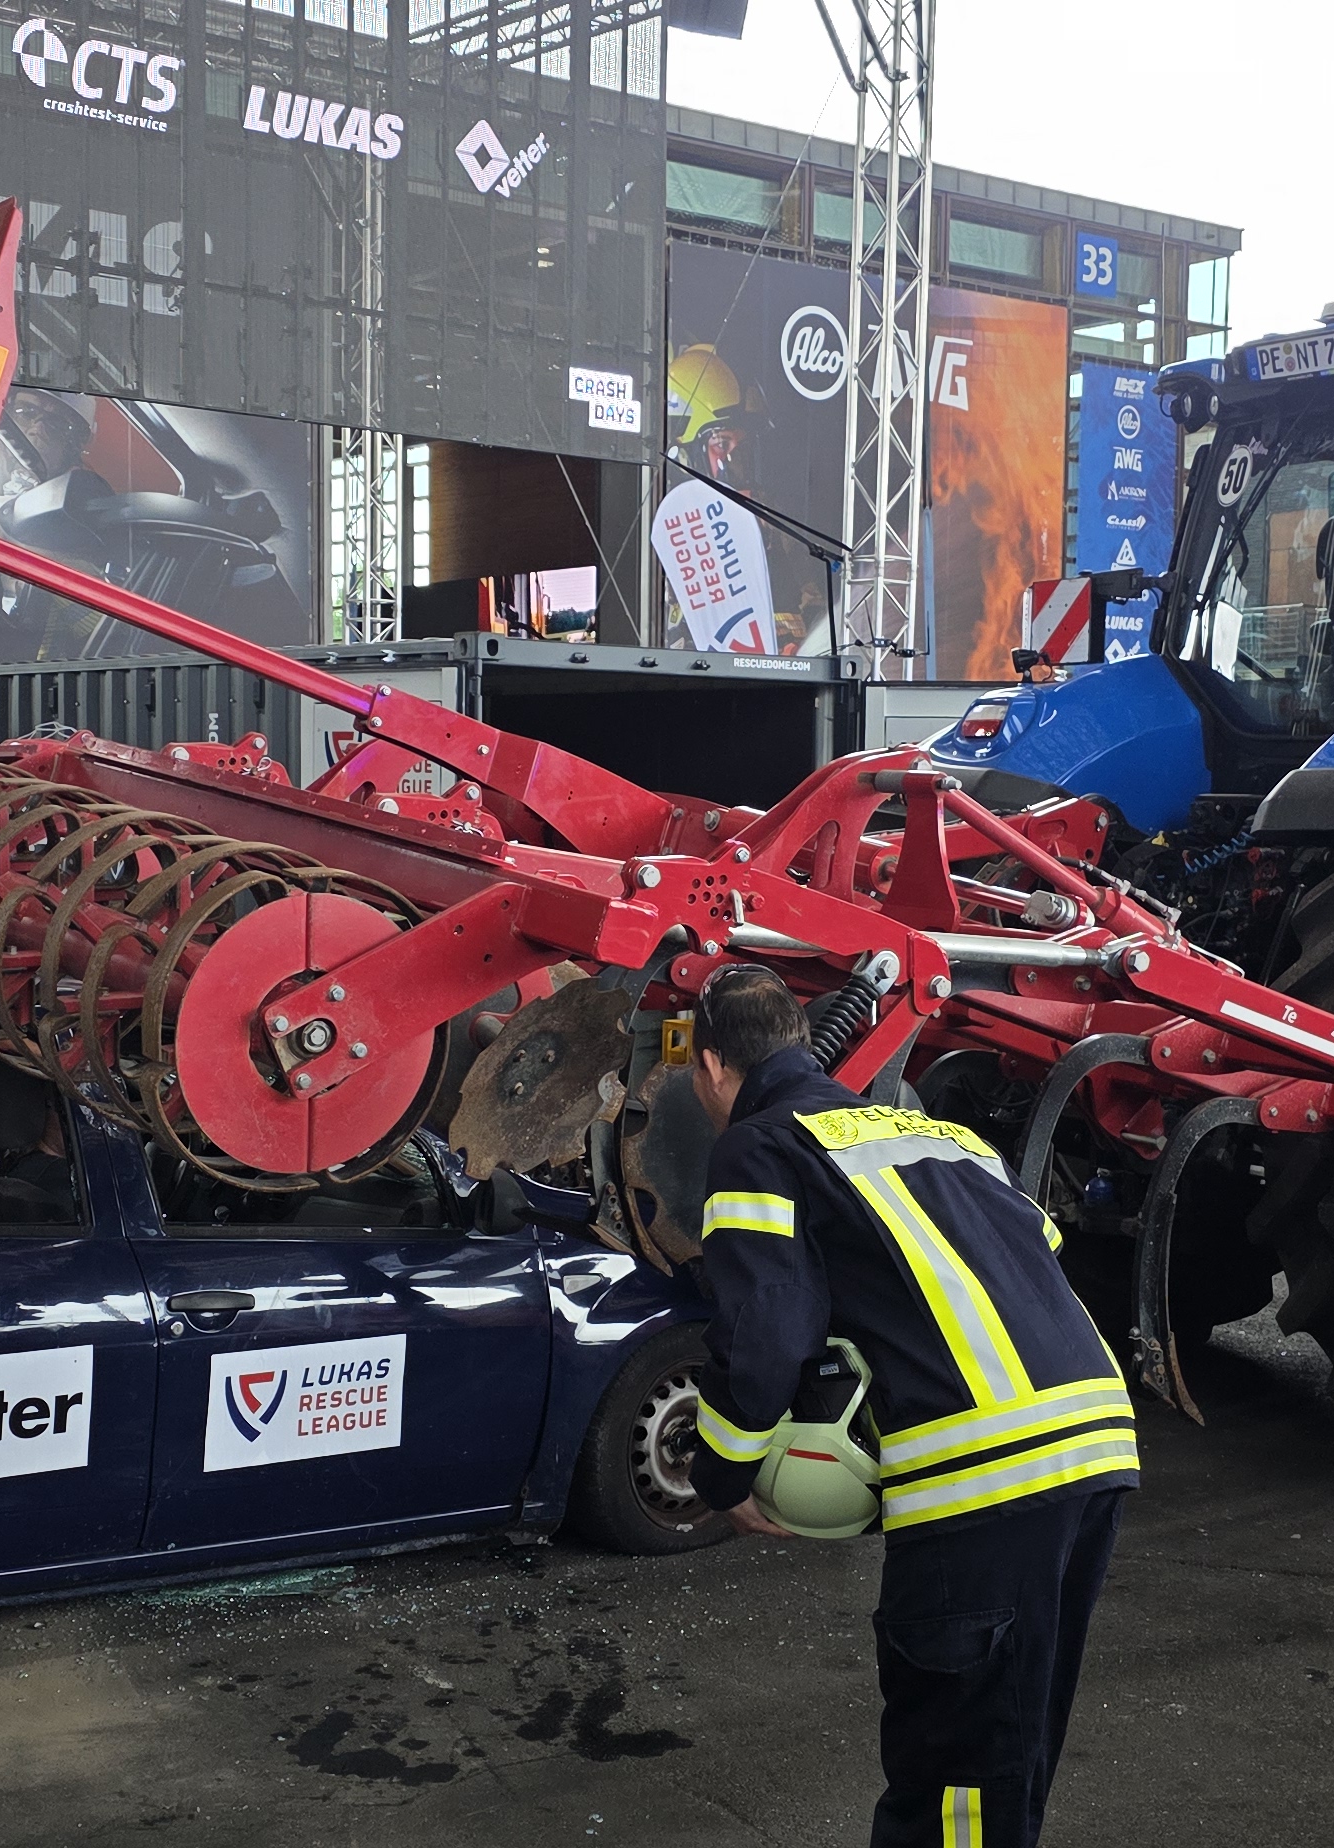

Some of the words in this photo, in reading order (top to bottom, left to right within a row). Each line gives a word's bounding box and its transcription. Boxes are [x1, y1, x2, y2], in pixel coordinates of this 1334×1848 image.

[71, 40, 181, 112] CTS
[43, 97, 168, 132] crashtest-service
[243, 84, 405, 160] LUKAS
[1082, 243, 1113, 286] 33
[788, 326, 845, 375] Alco
[1259, 346, 1284, 376] PE
[1295, 341, 1319, 370] NT
[574, 376, 627, 399] CRASH
[594, 404, 635, 424] DAYS
[1221, 456, 1249, 496] 50
[733, 658, 811, 671] RESCUEDOME.COM
[1281, 1004, 1298, 1024] Te
[301, 1357, 392, 1388] LUKAS
[299, 1383, 389, 1413] RESCUE
[296, 1408, 388, 1438] LEAGUE
